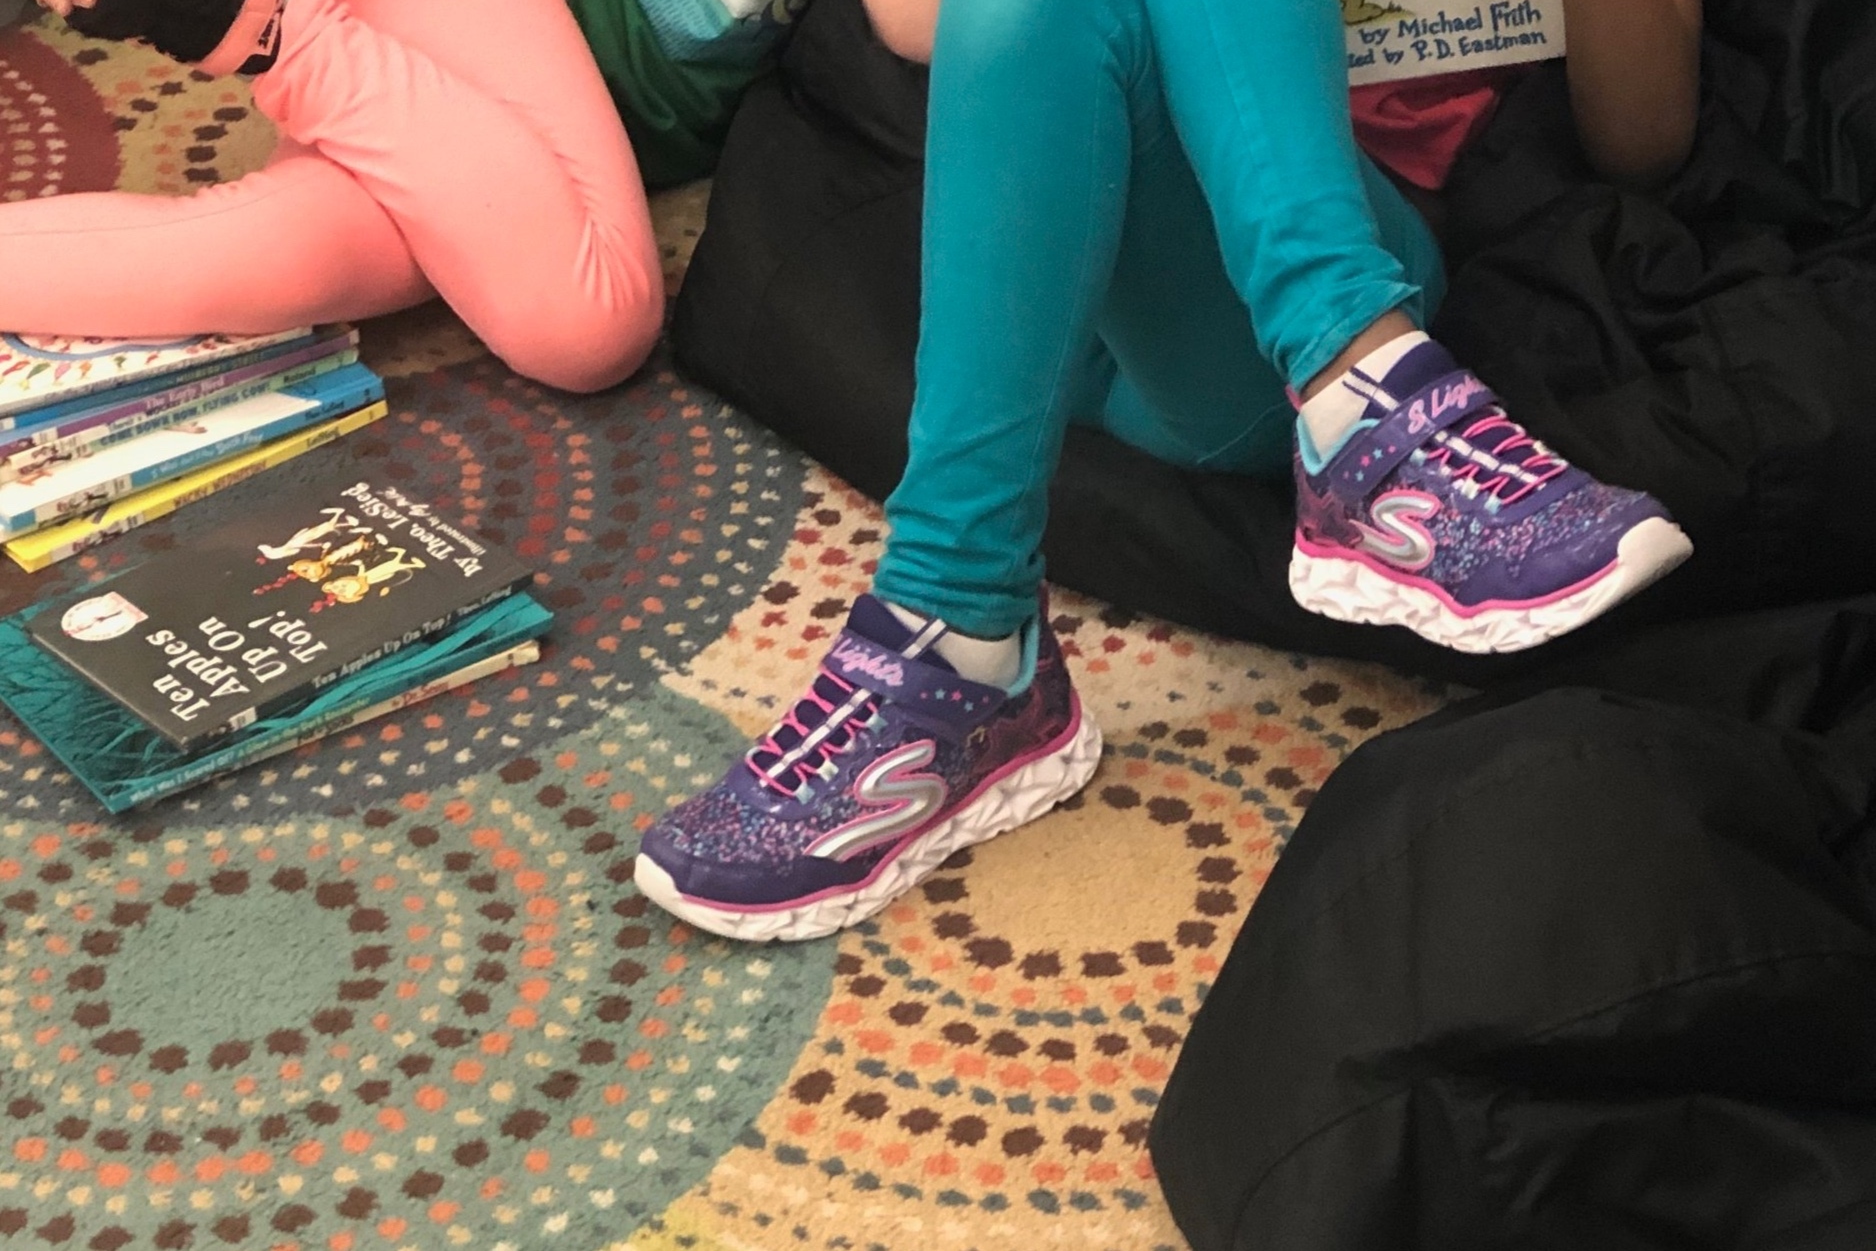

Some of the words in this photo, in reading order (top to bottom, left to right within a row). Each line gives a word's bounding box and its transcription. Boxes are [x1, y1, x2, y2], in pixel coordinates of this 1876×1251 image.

[1359, 27, 1390, 45] by
[1397, 6, 1483, 39] Michael
[1383, 49, 1404, 65] by
[1458, 30, 1546, 57] Eastman
[340, 481, 409, 530] LeSieg
[409, 522, 456, 561] Theo.
[453, 557, 483, 578] by
[198, 616, 246, 652] On
[247, 610, 329, 664] Top!
[145, 629, 251, 698] Apples
[241, 646, 288, 684] Up
[312, 672, 337, 689] Ten
[340, 649, 382, 678] Apples
[384, 638, 401, 655] Up
[403, 629, 421, 644] On
[152, 673, 211, 722] Ten
